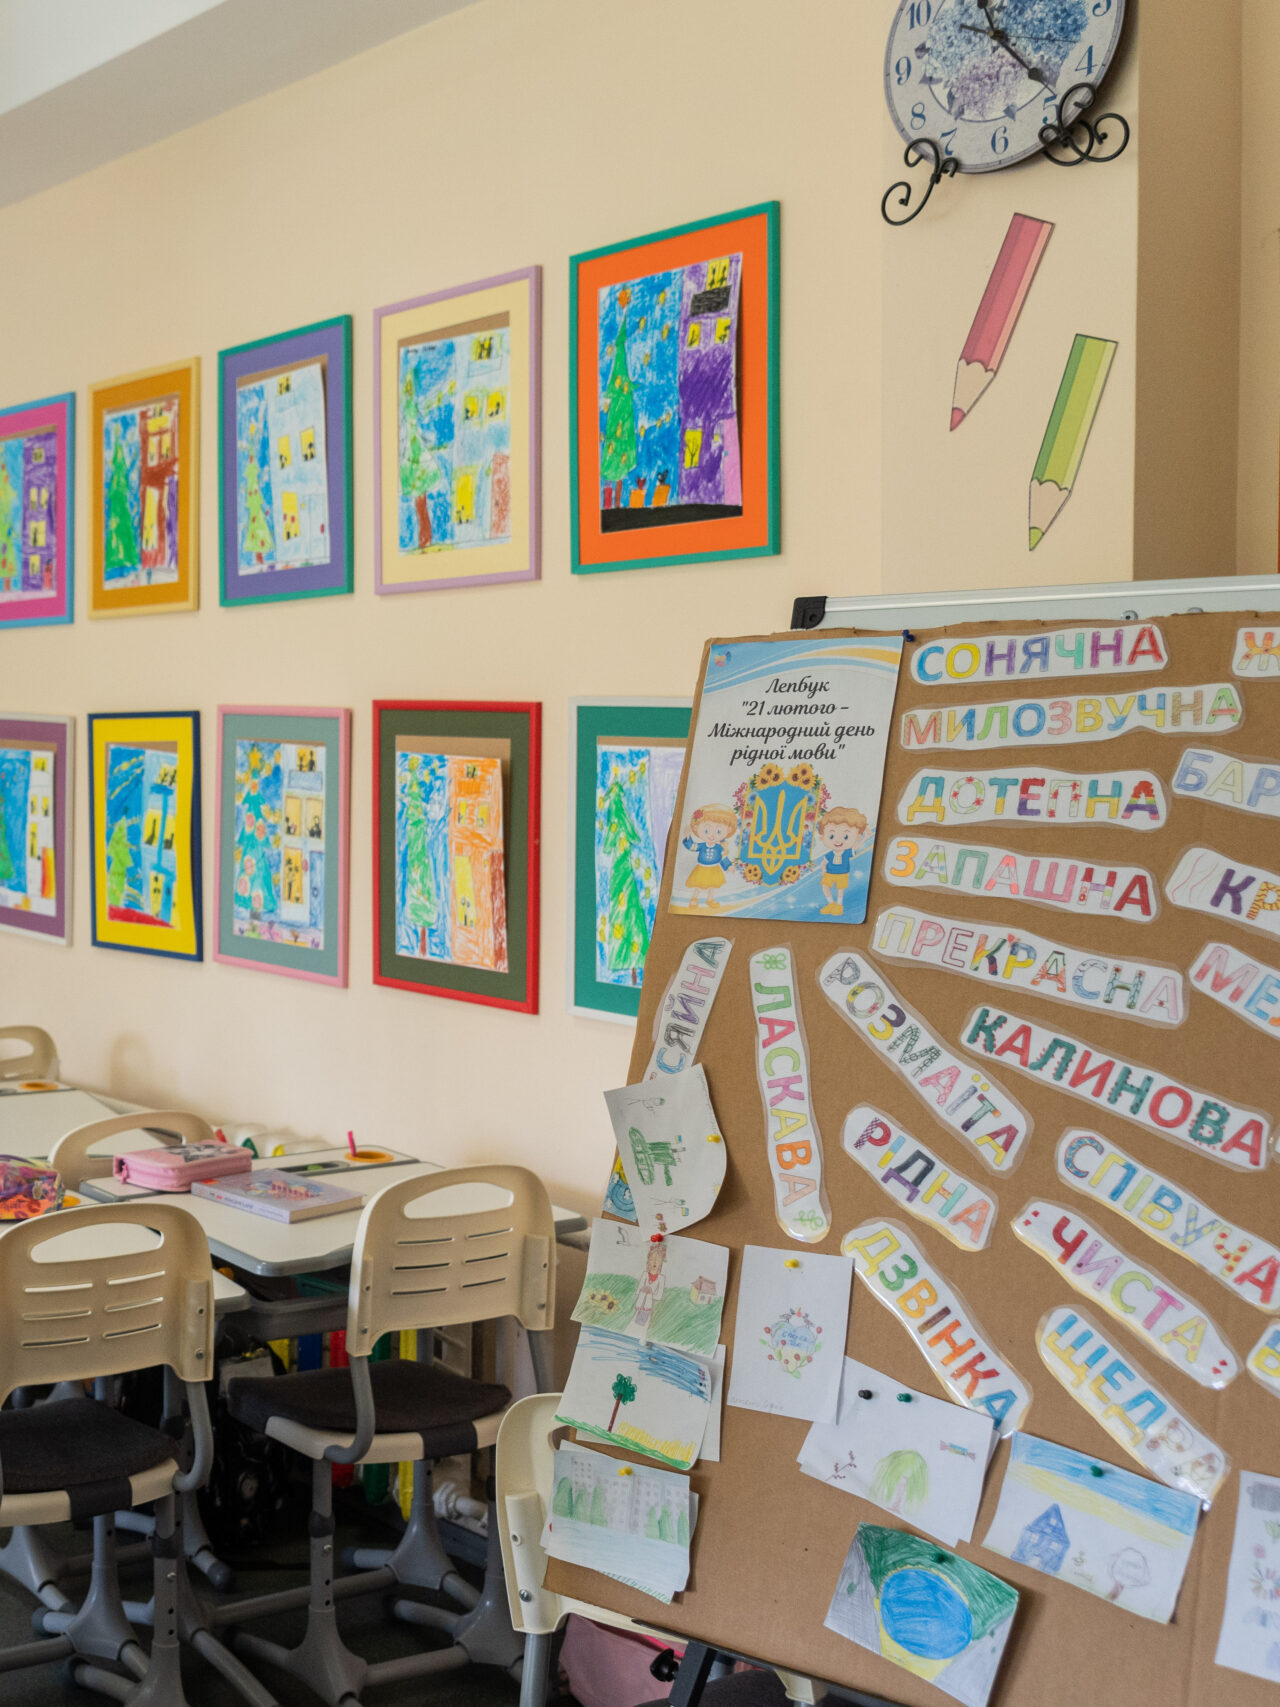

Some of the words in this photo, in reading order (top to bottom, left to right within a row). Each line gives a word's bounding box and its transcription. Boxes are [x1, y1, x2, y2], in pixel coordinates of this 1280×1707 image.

[905, 0, 931, 31] 10
[895, 56, 912, 86] 9
[1075, 45, 1098, 77] 4
[910, 102, 927, 131] 8
[1042, 94, 1060, 125] 5
[940, 127, 957, 156] 7
[990, 126, 1009, 155] 6
[917, 626, 1164, 681] СОНЯЧНА
[742, 700, 766, 716] "21
[767, 703, 837, 716] лютого
[765, 675, 831, 699] Лепбук
[707, 722, 832, 745] Міжнародний
[834, 724, 876, 744] день
[904, 687, 1239, 746] МИЛОЗВУЧНА
[729, 744, 786, 766] рідної
[788, 742, 846, 760] мови"
[906, 775, 1160, 823] ДОТЕПНА
[890, 840, 1152, 917] ЗАПАШНА
[877, 913, 1179, 1021] ПРЕКРАСНА
[1193, 946, 1280, 1027] МЕ
[649, 938, 726, 1081] СЯЙНА
[823, 957, 1019, 1166] РОЗМАЇТА
[966, 1006, 1264, 1167] КАЛИНОВА
[753, 982, 818, 1208] ЛАСКАВА
[853, 1116, 991, 1245] РІДНА
[1064, 1135, 1280, 1304] СПІВУЧА
[1051, 1215, 1208, 1364] ЧИСТА
[845, 1227, 1018, 1431] ДЗВІНКА
